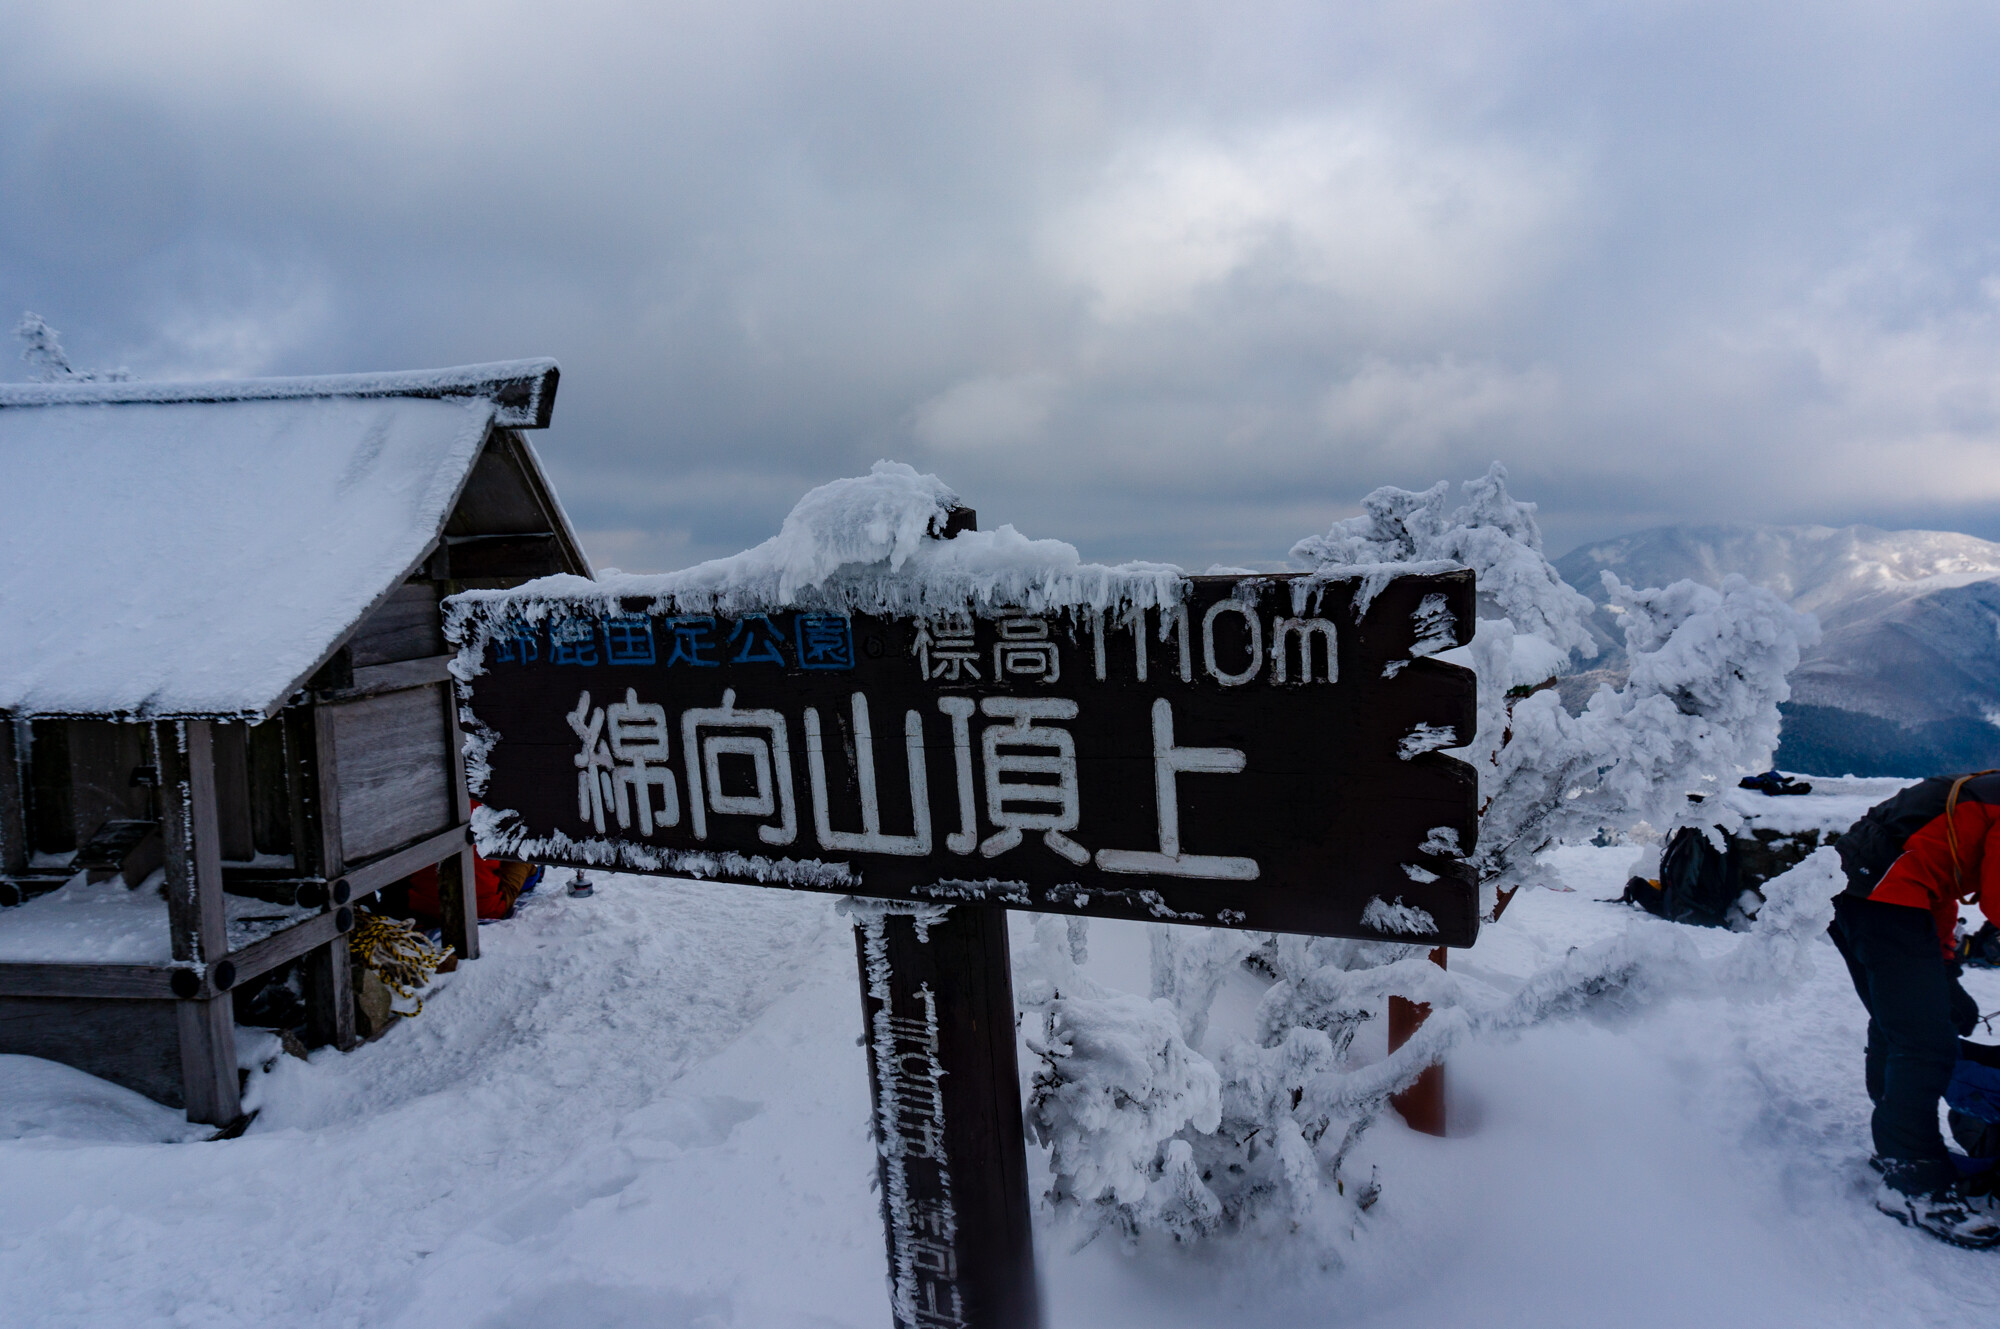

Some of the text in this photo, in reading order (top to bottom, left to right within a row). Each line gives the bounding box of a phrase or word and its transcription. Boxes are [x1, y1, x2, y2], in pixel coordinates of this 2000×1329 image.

[567, 687, 1261, 881] 綿向山頂上
